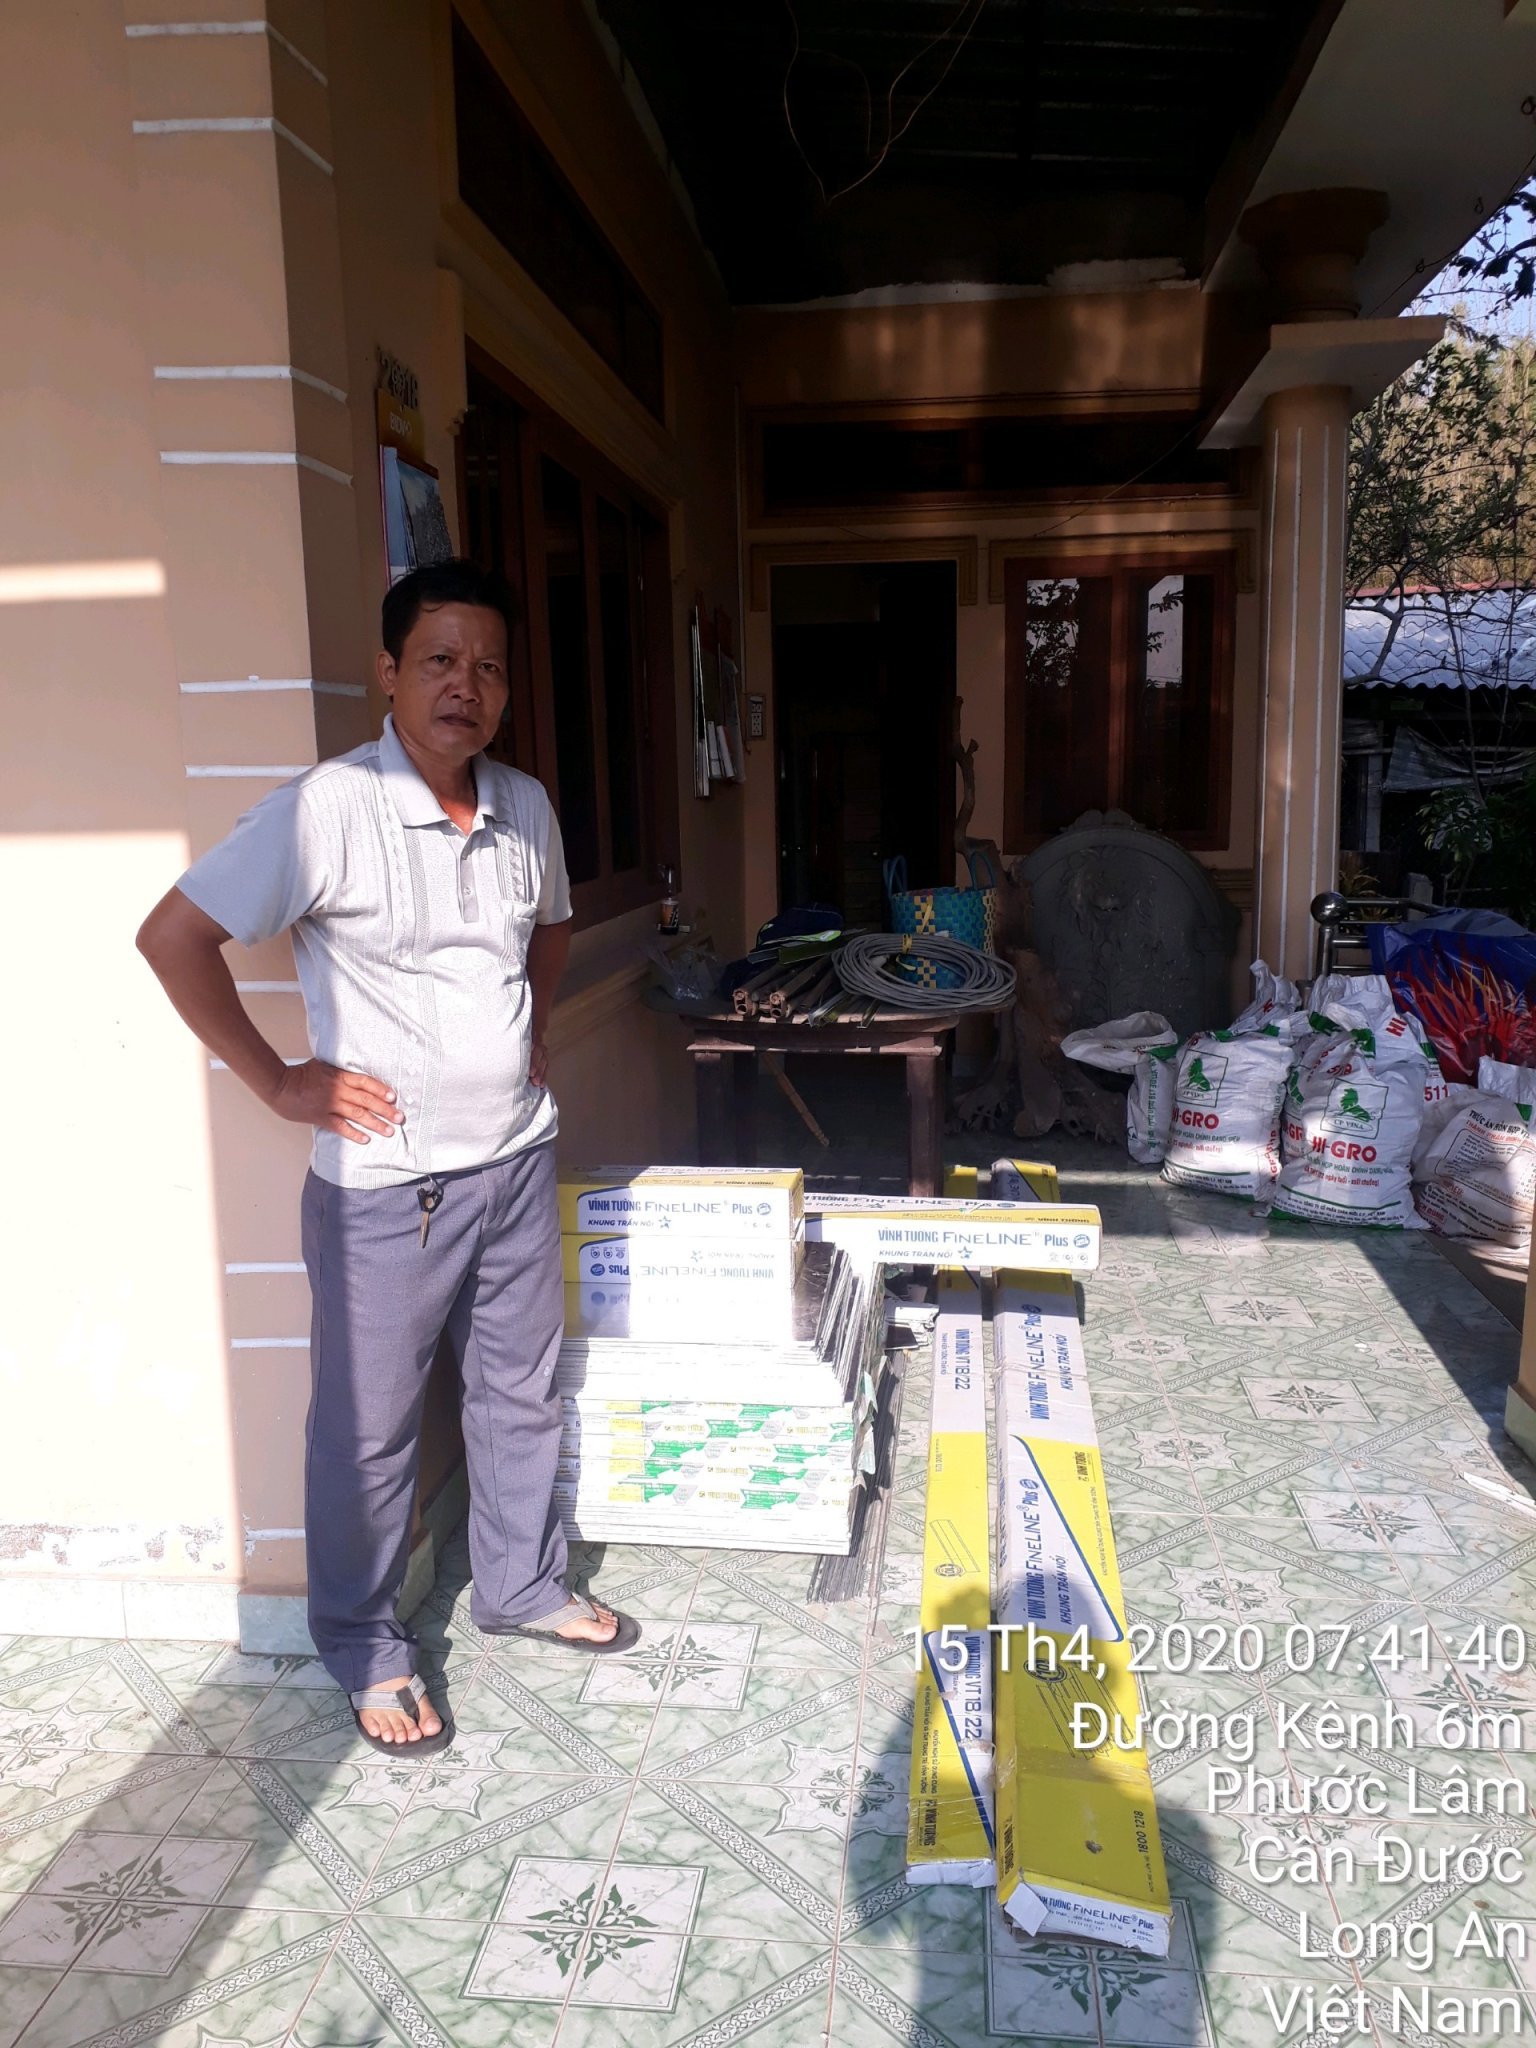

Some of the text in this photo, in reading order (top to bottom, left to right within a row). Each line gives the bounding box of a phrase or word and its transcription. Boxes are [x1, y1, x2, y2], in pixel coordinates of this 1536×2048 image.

[1312, 1136, 1377, 1163] HI-GRO
[732, 1203, 753, 1215] Plus
[588, 1219, 616, 1227] KHUNG
[1044, 1233, 1069, 1247] Plus
[608, 1264, 630, 1276] Plus
[1024, 1313, 1042, 1327] Plus
[1021, 1491, 1039, 1506] Plus
[1058, 1593, 1073, 1625] KHUNG
[925, 1808, 939, 1823] VĨNH
[1133, 1810, 1145, 1828] 1218
[1136, 1831, 1149, 1853] 1800
[1138, 1918, 1155, 1930] Plus
